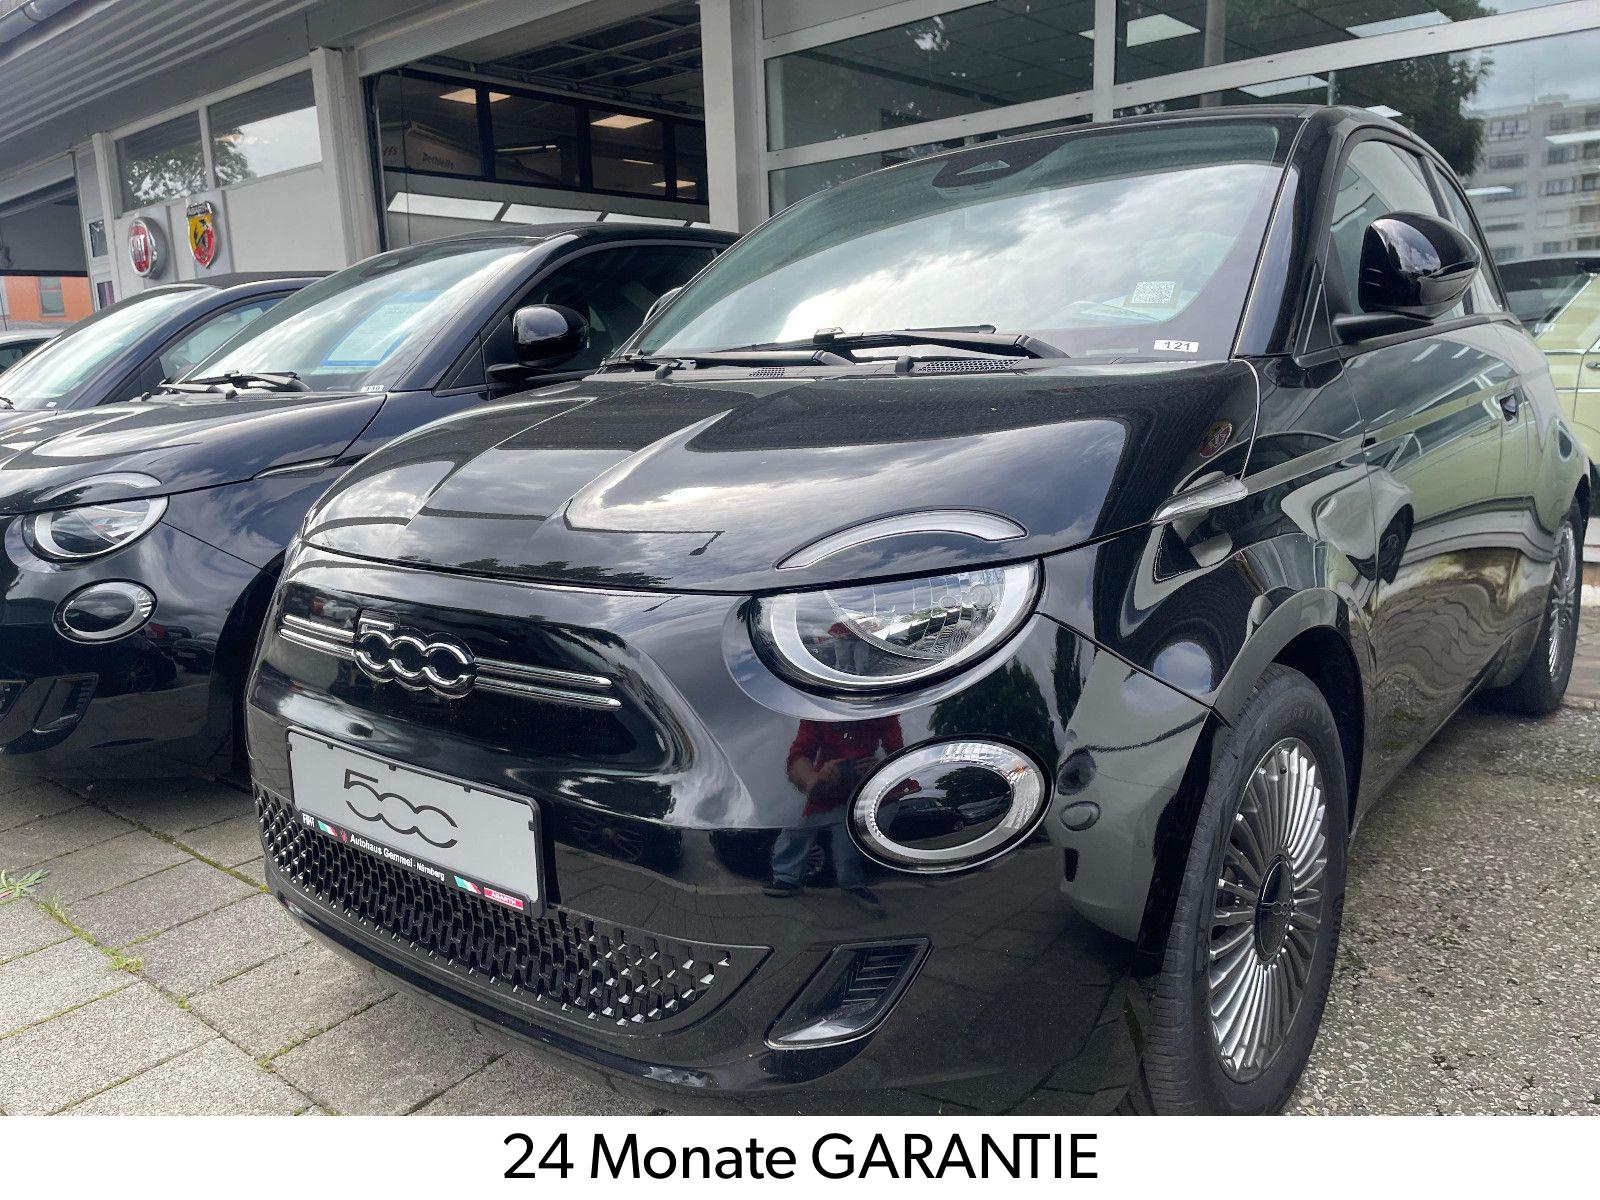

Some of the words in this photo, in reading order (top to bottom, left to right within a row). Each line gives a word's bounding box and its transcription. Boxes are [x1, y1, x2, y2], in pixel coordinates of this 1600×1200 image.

[1164, 341, 1190, 351] 121
[356, 616, 471, 688] 500
[343, 768, 458, 849] 500
[350, 834, 383, 855] Autohaus
[383, 847, 413, 868] Gemmel
